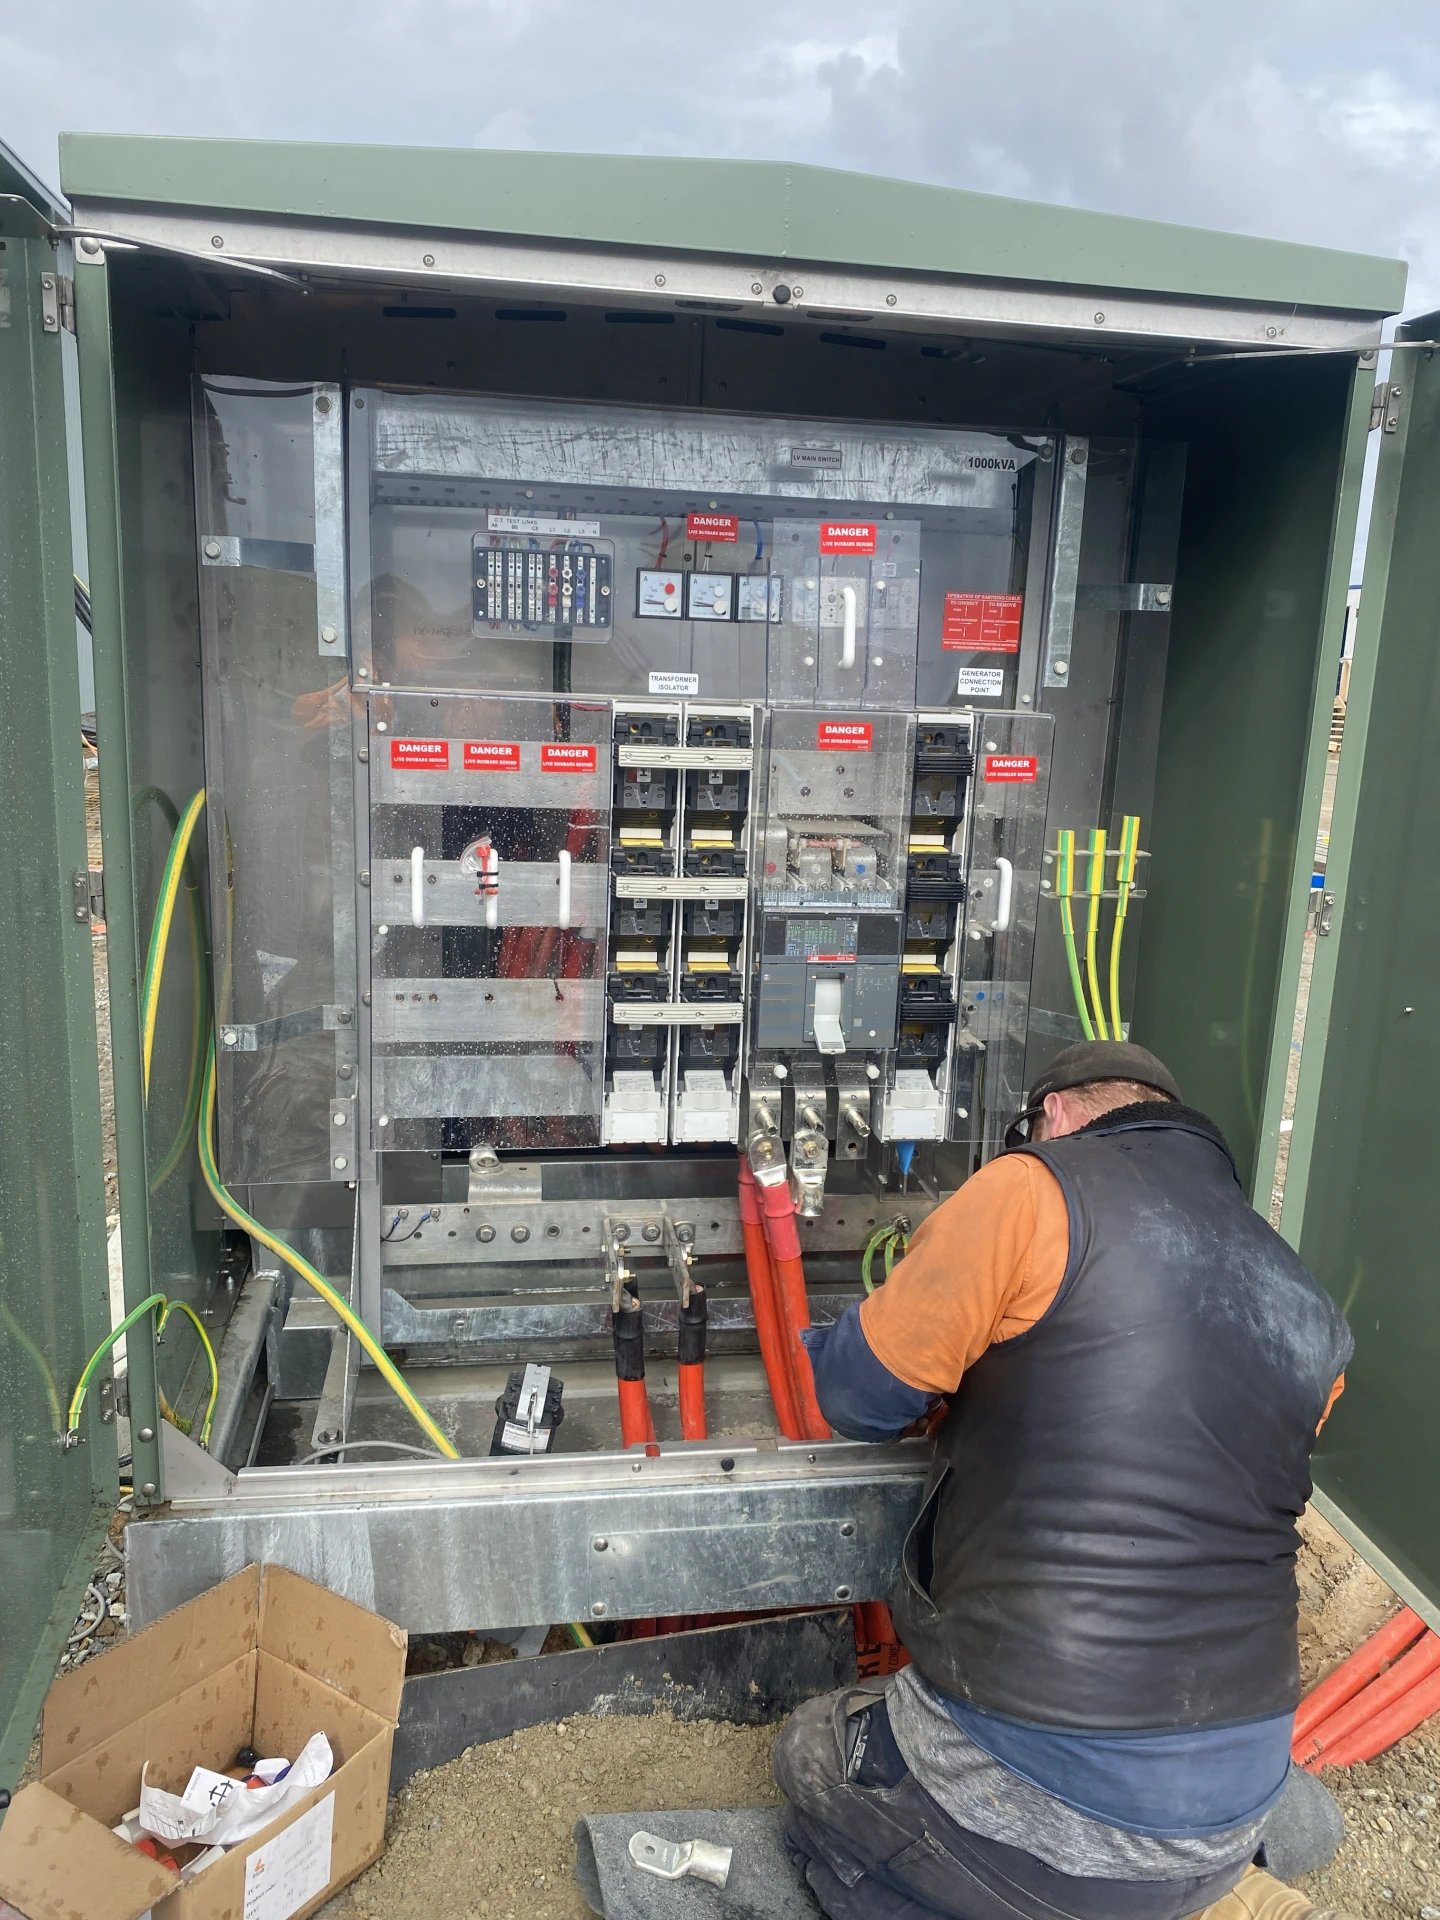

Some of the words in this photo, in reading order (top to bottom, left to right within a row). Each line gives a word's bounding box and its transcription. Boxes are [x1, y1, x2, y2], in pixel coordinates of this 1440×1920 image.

[968, 457, 1015, 470] 1000kVA
[694, 517, 731, 526] DANGER
[828, 527, 869, 536] DANGER
[826, 726, 864, 734] DANGER
[399, 744, 442, 753] DANGER
[470, 746, 512, 755] DANGER
[548, 748, 588, 757] DANGER
[888, 1644, 901, 1666] CORE
